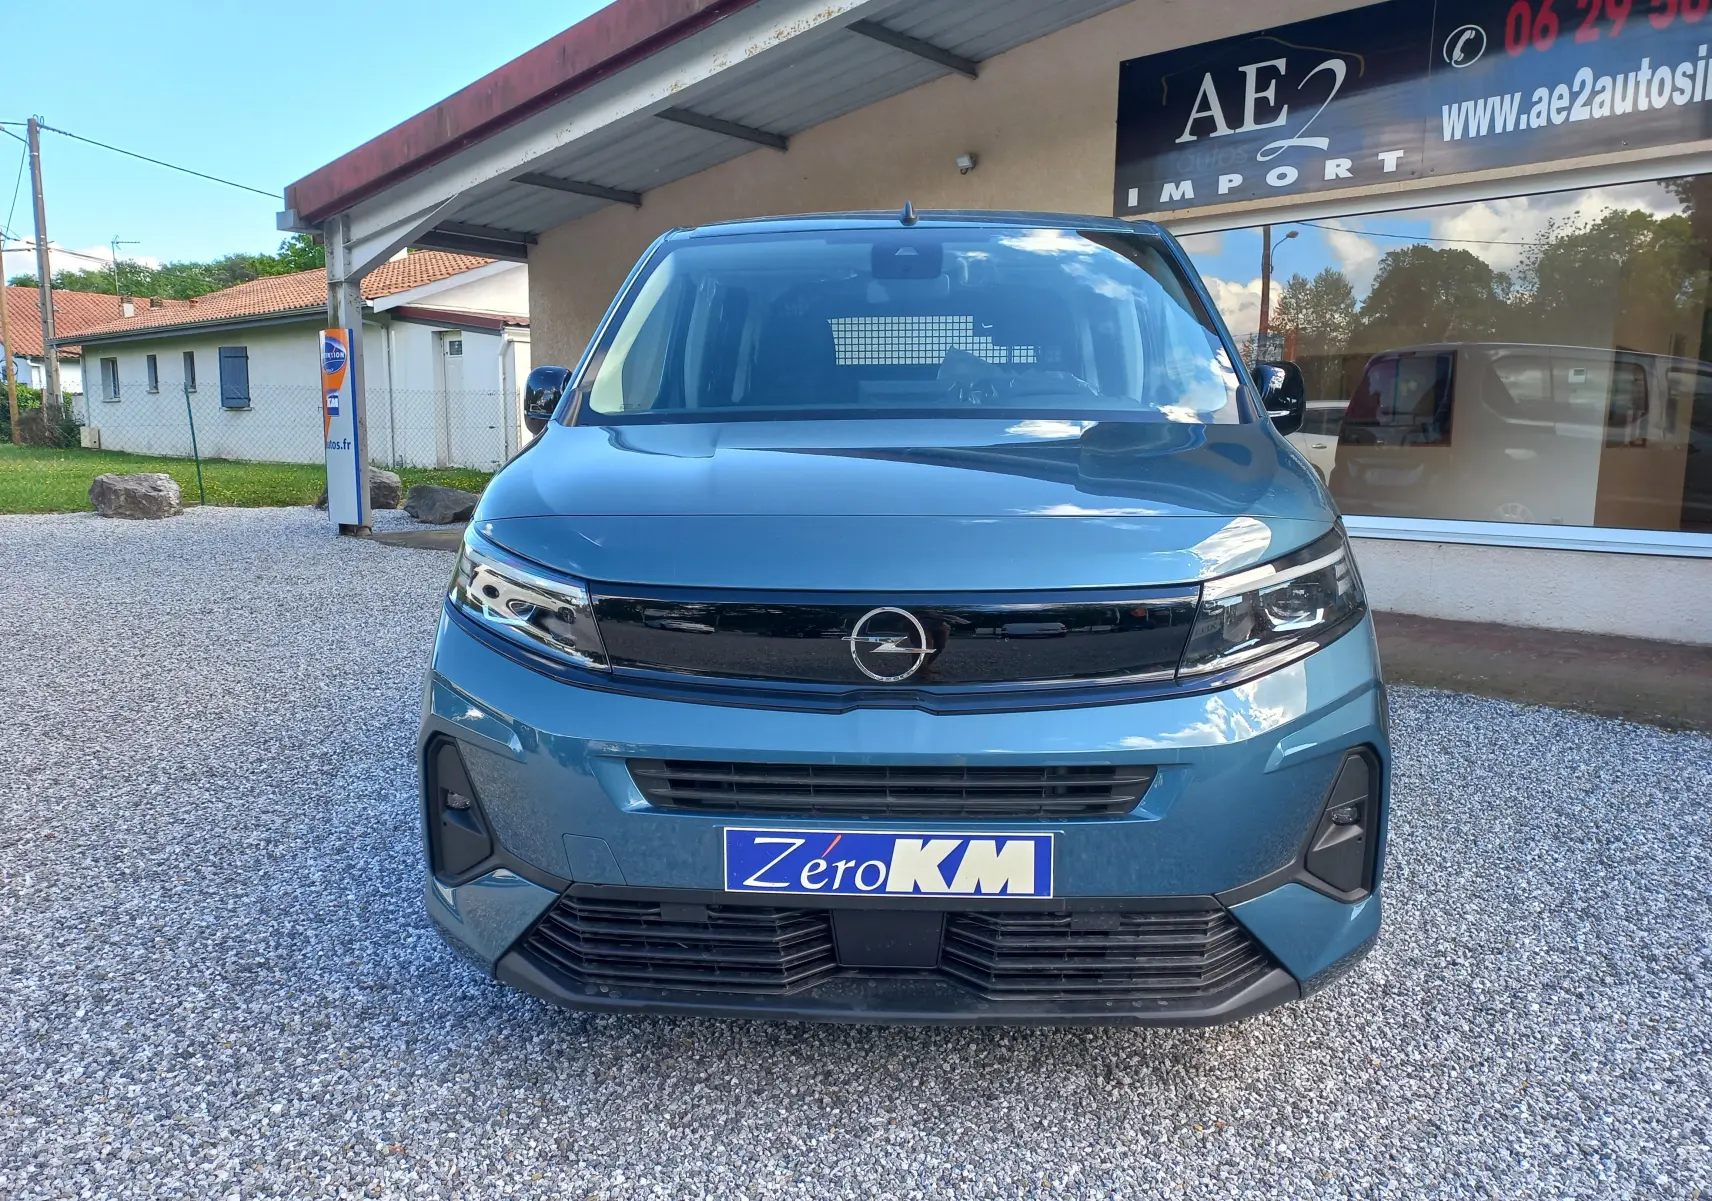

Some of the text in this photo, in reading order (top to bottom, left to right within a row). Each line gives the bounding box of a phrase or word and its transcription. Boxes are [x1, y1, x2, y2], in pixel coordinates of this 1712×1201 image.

[1504, 0, 1559, 57] 06
[1573, 0, 1632, 44] 29
[1441, 44, 1712, 142] www.ae2autosi
[1127, 150, 1405, 208] IMPORT
